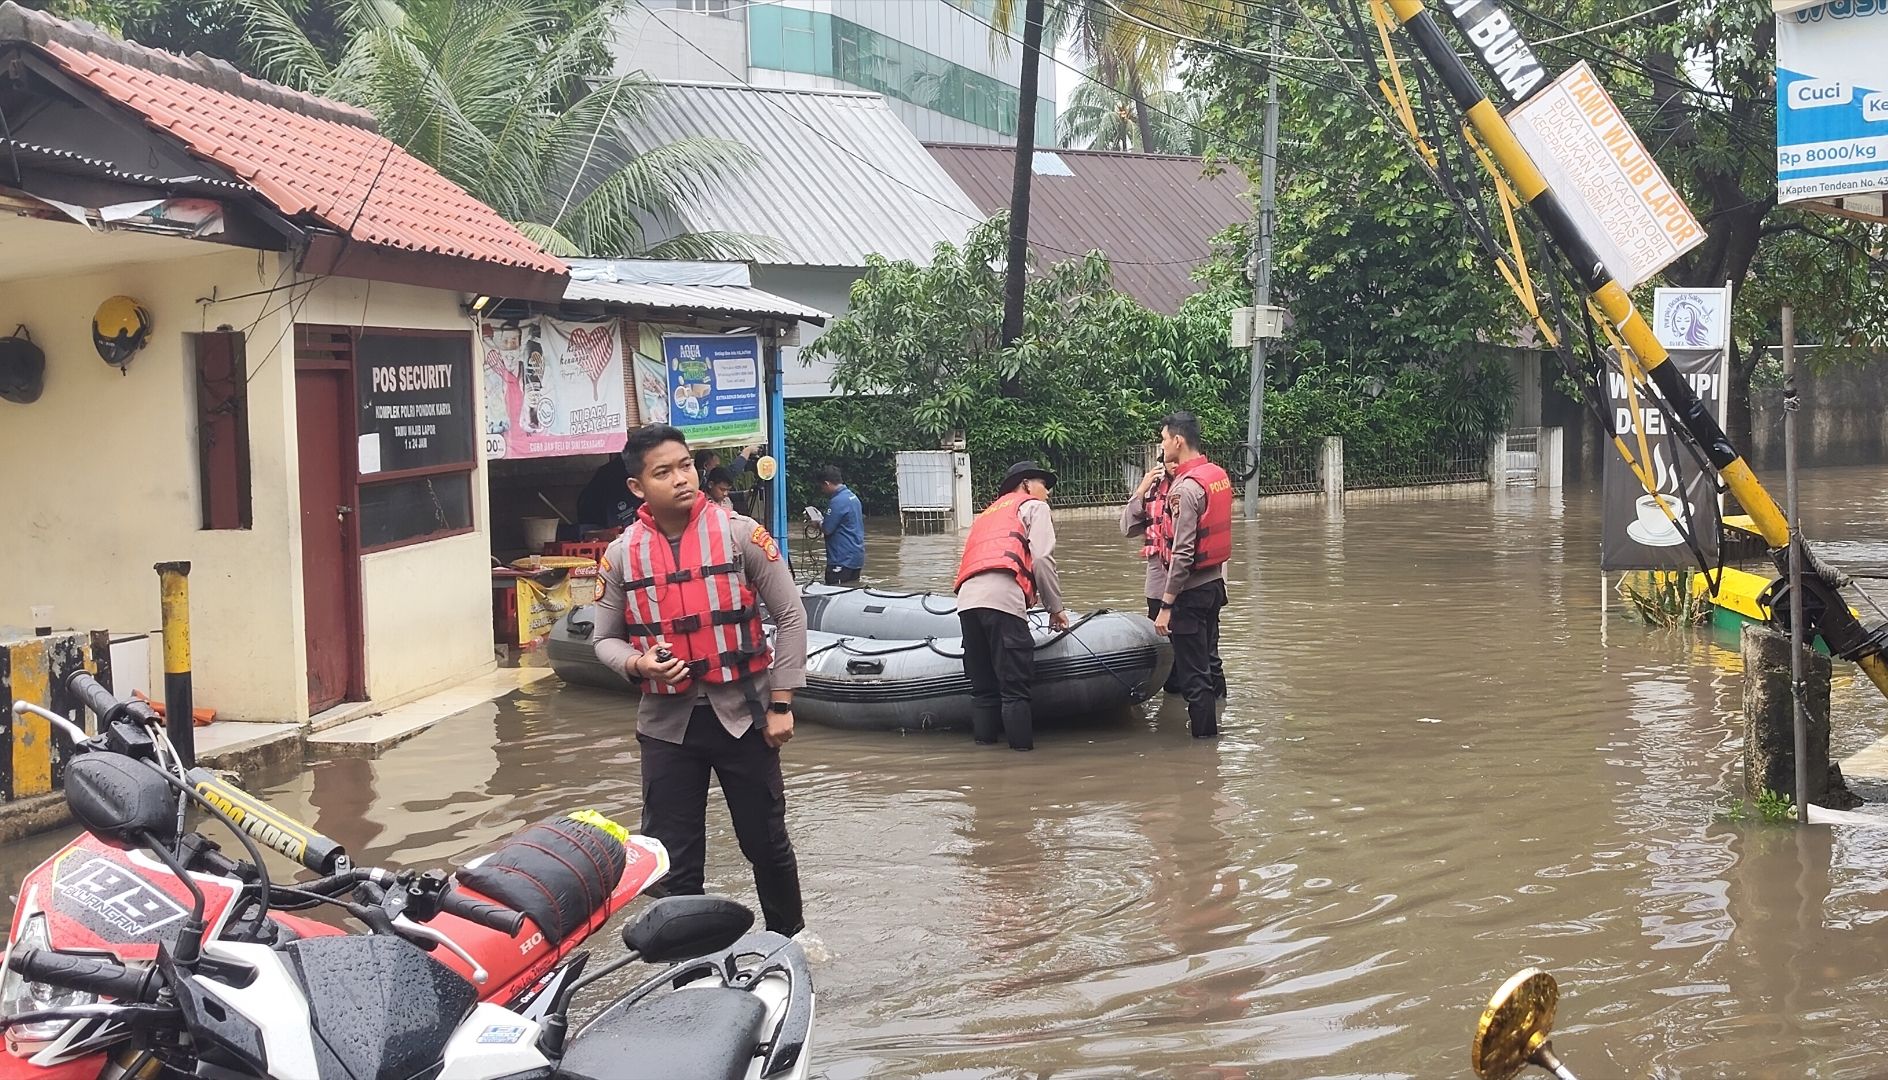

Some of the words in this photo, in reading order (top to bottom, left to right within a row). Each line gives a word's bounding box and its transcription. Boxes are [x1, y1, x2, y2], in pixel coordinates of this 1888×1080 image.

[1467, 9, 1544, 101] BUKA
[1798, 82, 1840, 101] Cuci
[1568, 71, 1614, 127] TAMU
[1602, 124, 1653, 186] WAJIB
[1641, 181, 1697, 246] LAPOR
[1779, 152, 1801, 166] Rp
[1806, 143, 1876, 162] 8000/kg
[1545, 108, 1594, 174] TUNJUKAN
[1589, 172, 1639, 239] IDENTITAS
[1633, 234, 1658, 265] DIRI
[1554, 98, 1584, 133] BUKA
[1579, 130, 1611, 172] HELM
[1610, 178, 1643, 217] KACA
[1639, 213, 1668, 256] MOBIL
[1785, 185, 1818, 196] Kapten
[1820, 180, 1858, 191] Tendean
[1860, 178, 1876, 188] No.
[1569, 167, 1610, 219] MAKSIMAL
[679, 344, 701, 360] AQUA
[372, 366, 397, 393] POS
[399, 364, 452, 391] SECURITY
[375, 405, 400, 419] KOMPLEK
[415, 403, 435, 417] PONDOK
[435, 402, 452, 416] KARYA
[570, 409, 582, 423] INI
[394, 426, 407, 437] TAMU
[407, 425, 421, 436] WAJIB
[421, 424, 436, 435] LAPOR
[569, 419, 594, 436] RASA
[594, 413, 620, 431] CAFE!
[957, 457, 966, 466] A1
[1209, 477, 1231, 494] POLISI
[60, 861, 180, 928] 199
